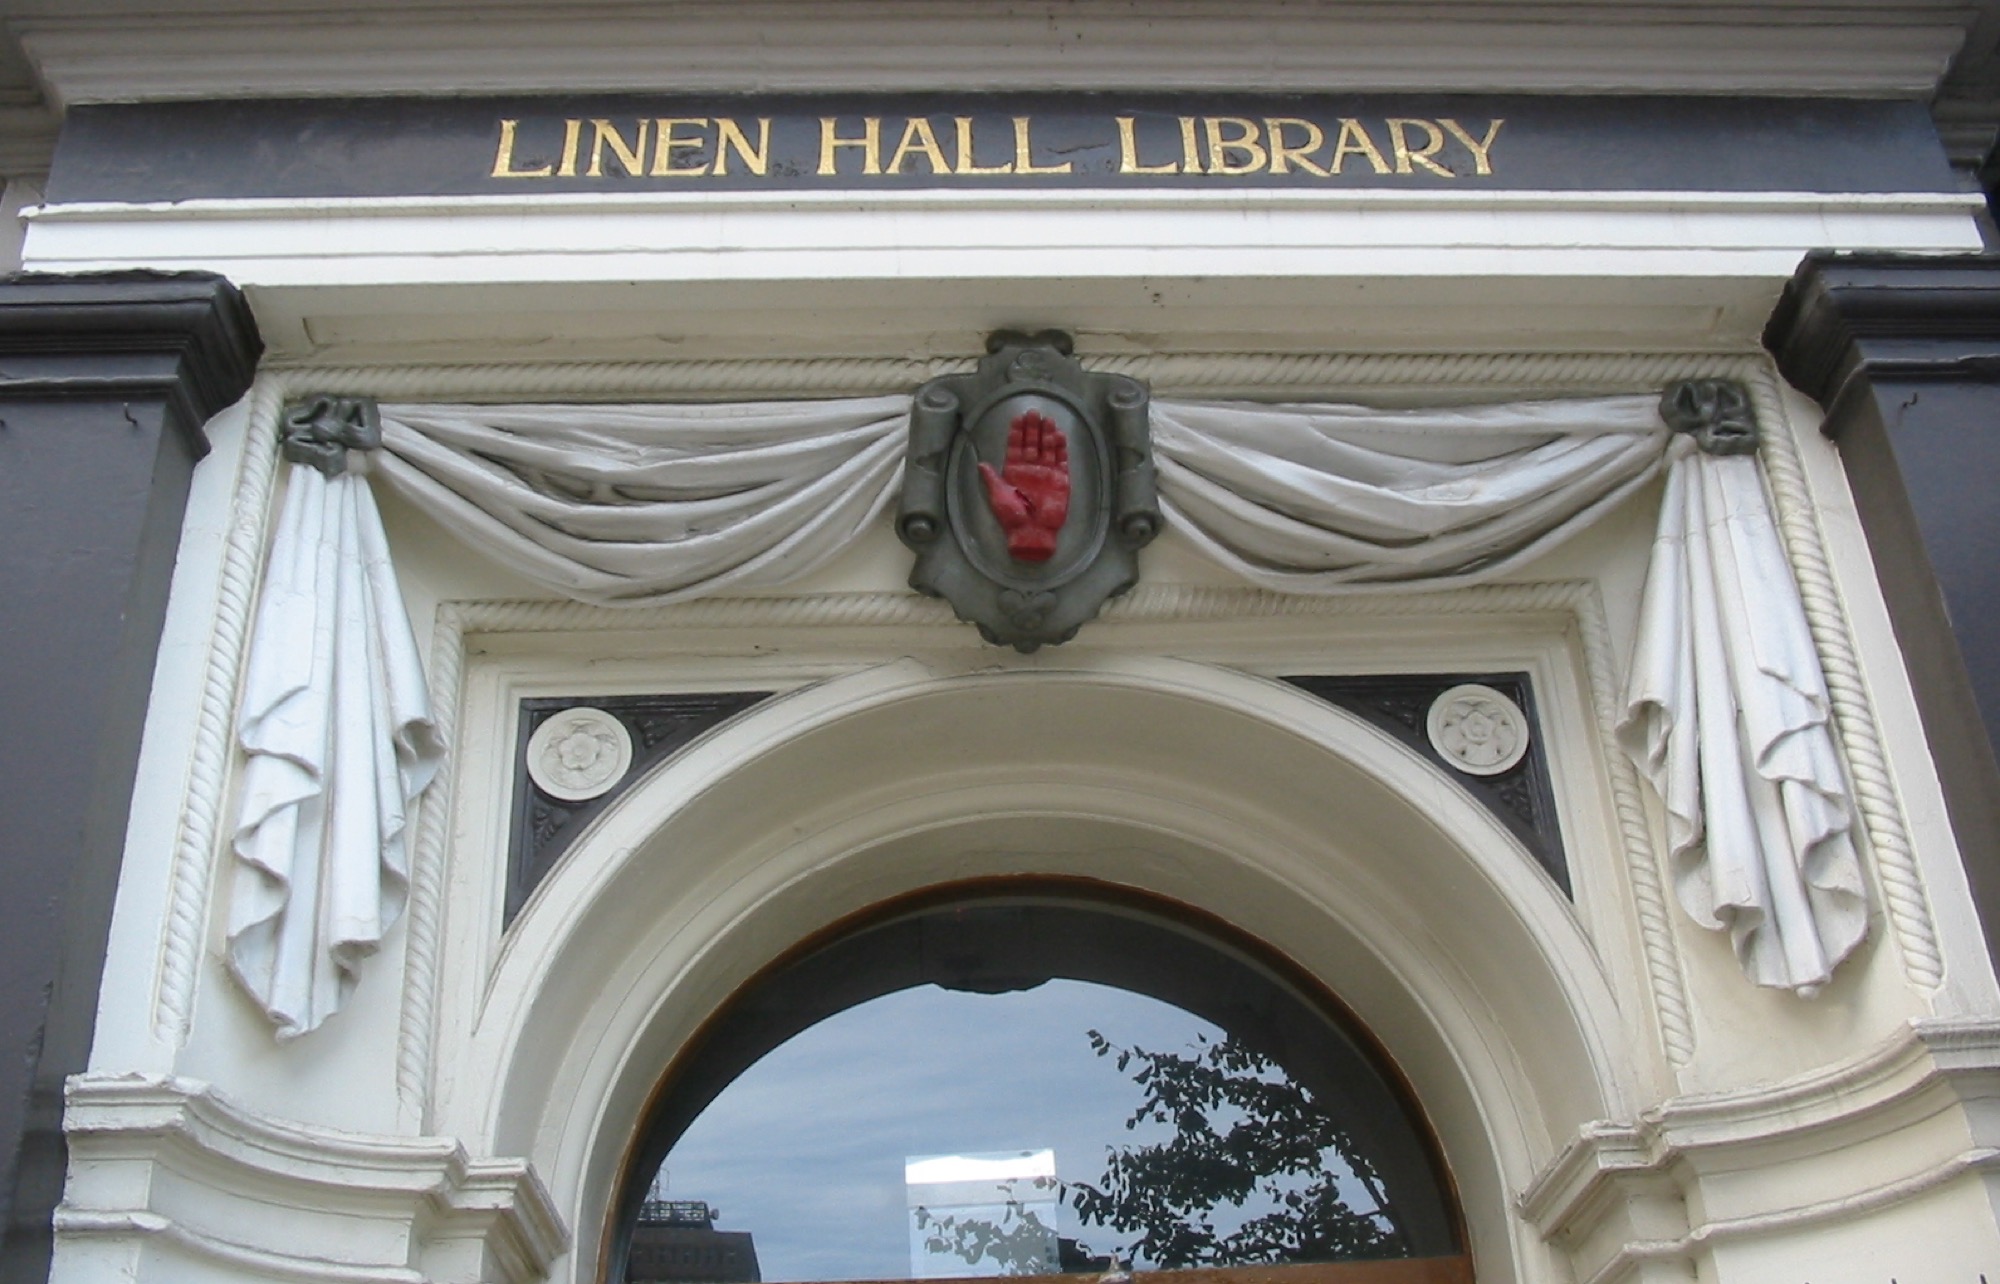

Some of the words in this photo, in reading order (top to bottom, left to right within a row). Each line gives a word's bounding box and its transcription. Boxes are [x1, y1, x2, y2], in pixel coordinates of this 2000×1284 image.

[489, 117, 770, 178] LINEN
[816, 116, 1073, 176] HALL
[1115, 116, 1505, 178] LIBRARY
